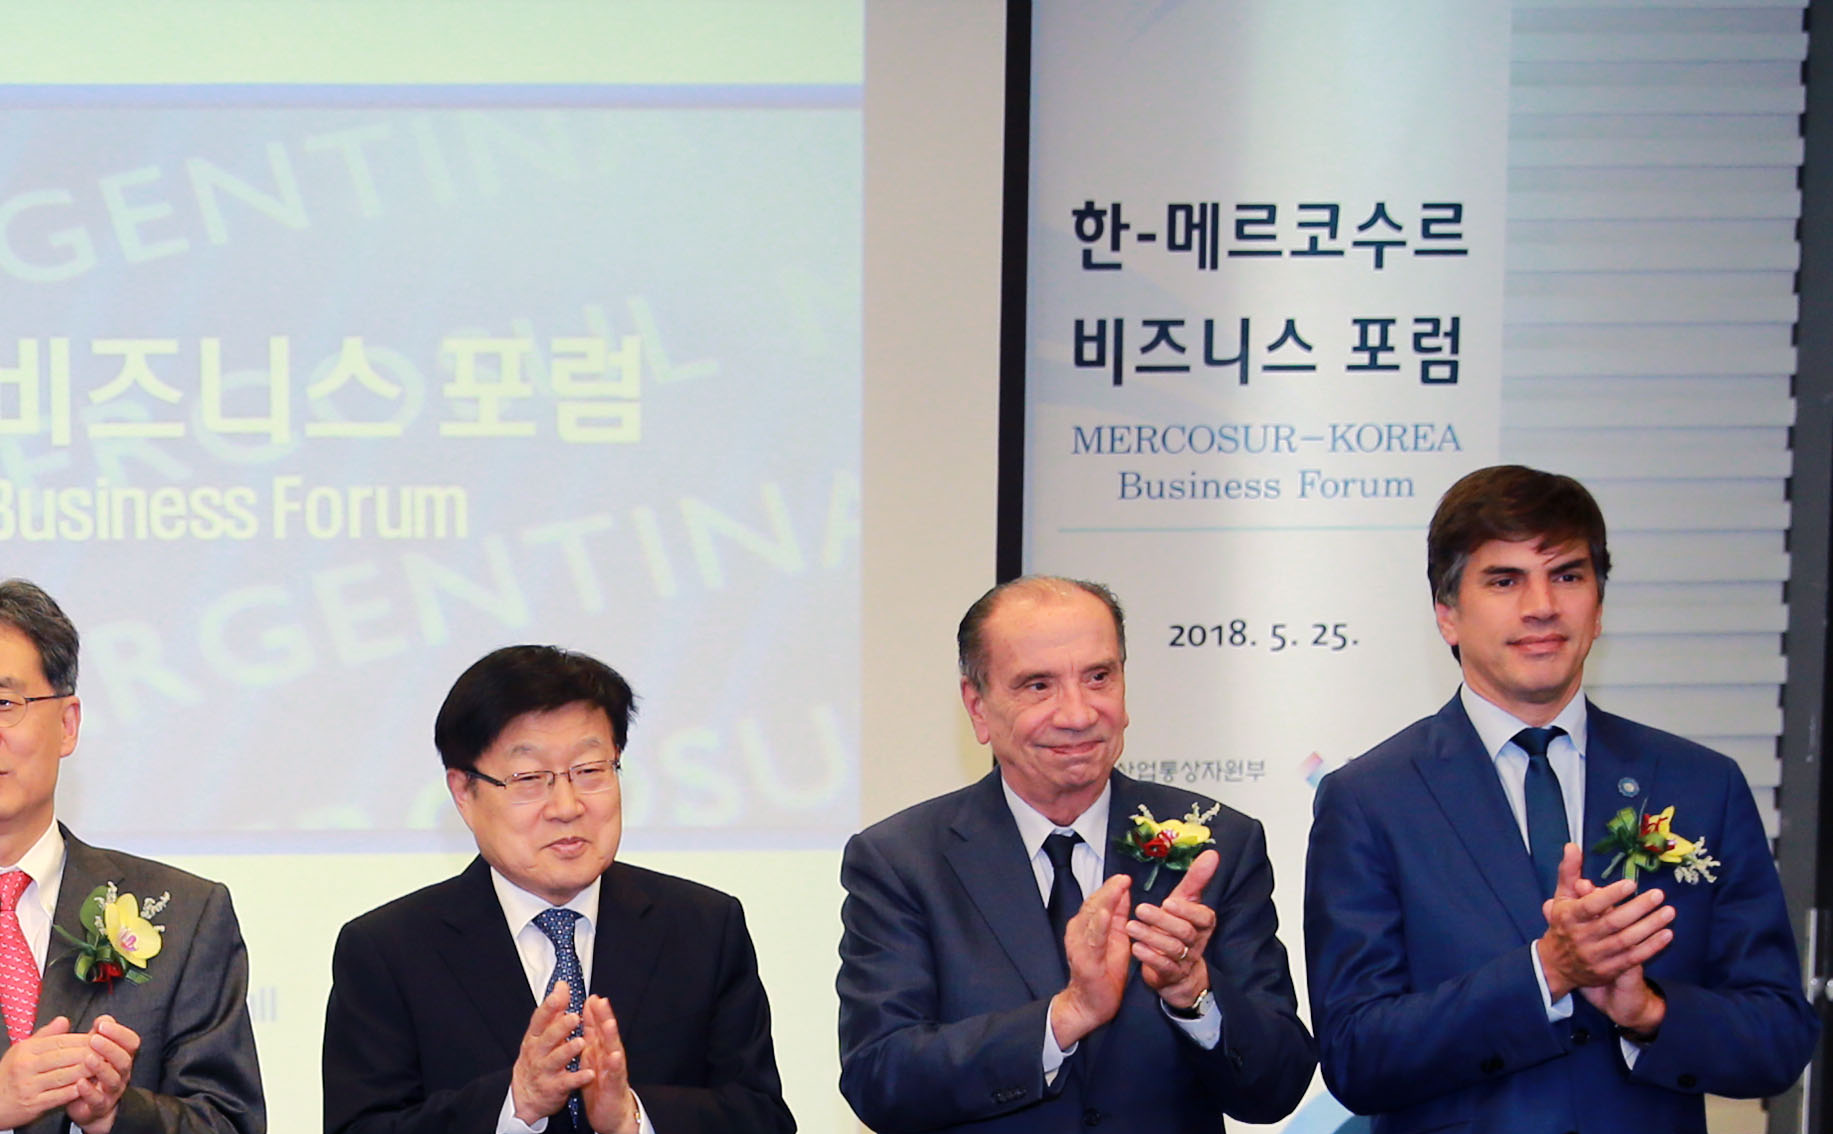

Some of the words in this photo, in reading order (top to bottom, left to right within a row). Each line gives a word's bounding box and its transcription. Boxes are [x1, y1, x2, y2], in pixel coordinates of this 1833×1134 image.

[1072, 200, 1469, 271] 한-메르코수르
[1073, 317, 1317, 387] 비즈니스
[1346, 316, 1461, 386] 포럼
[439, 335, 643, 444] 포럼
[1072, 422, 1461, 455] MERCOSUR-KOREA
[273, 475, 468, 540] Forum
[1118, 471, 1281, 501] Business
[1299, 471, 1415, 499] Forum
[1169, 619, 1255, 648] 2018.
[1271, 624, 1298, 652] 5.
[1312, 623, 1360, 651] 25.
